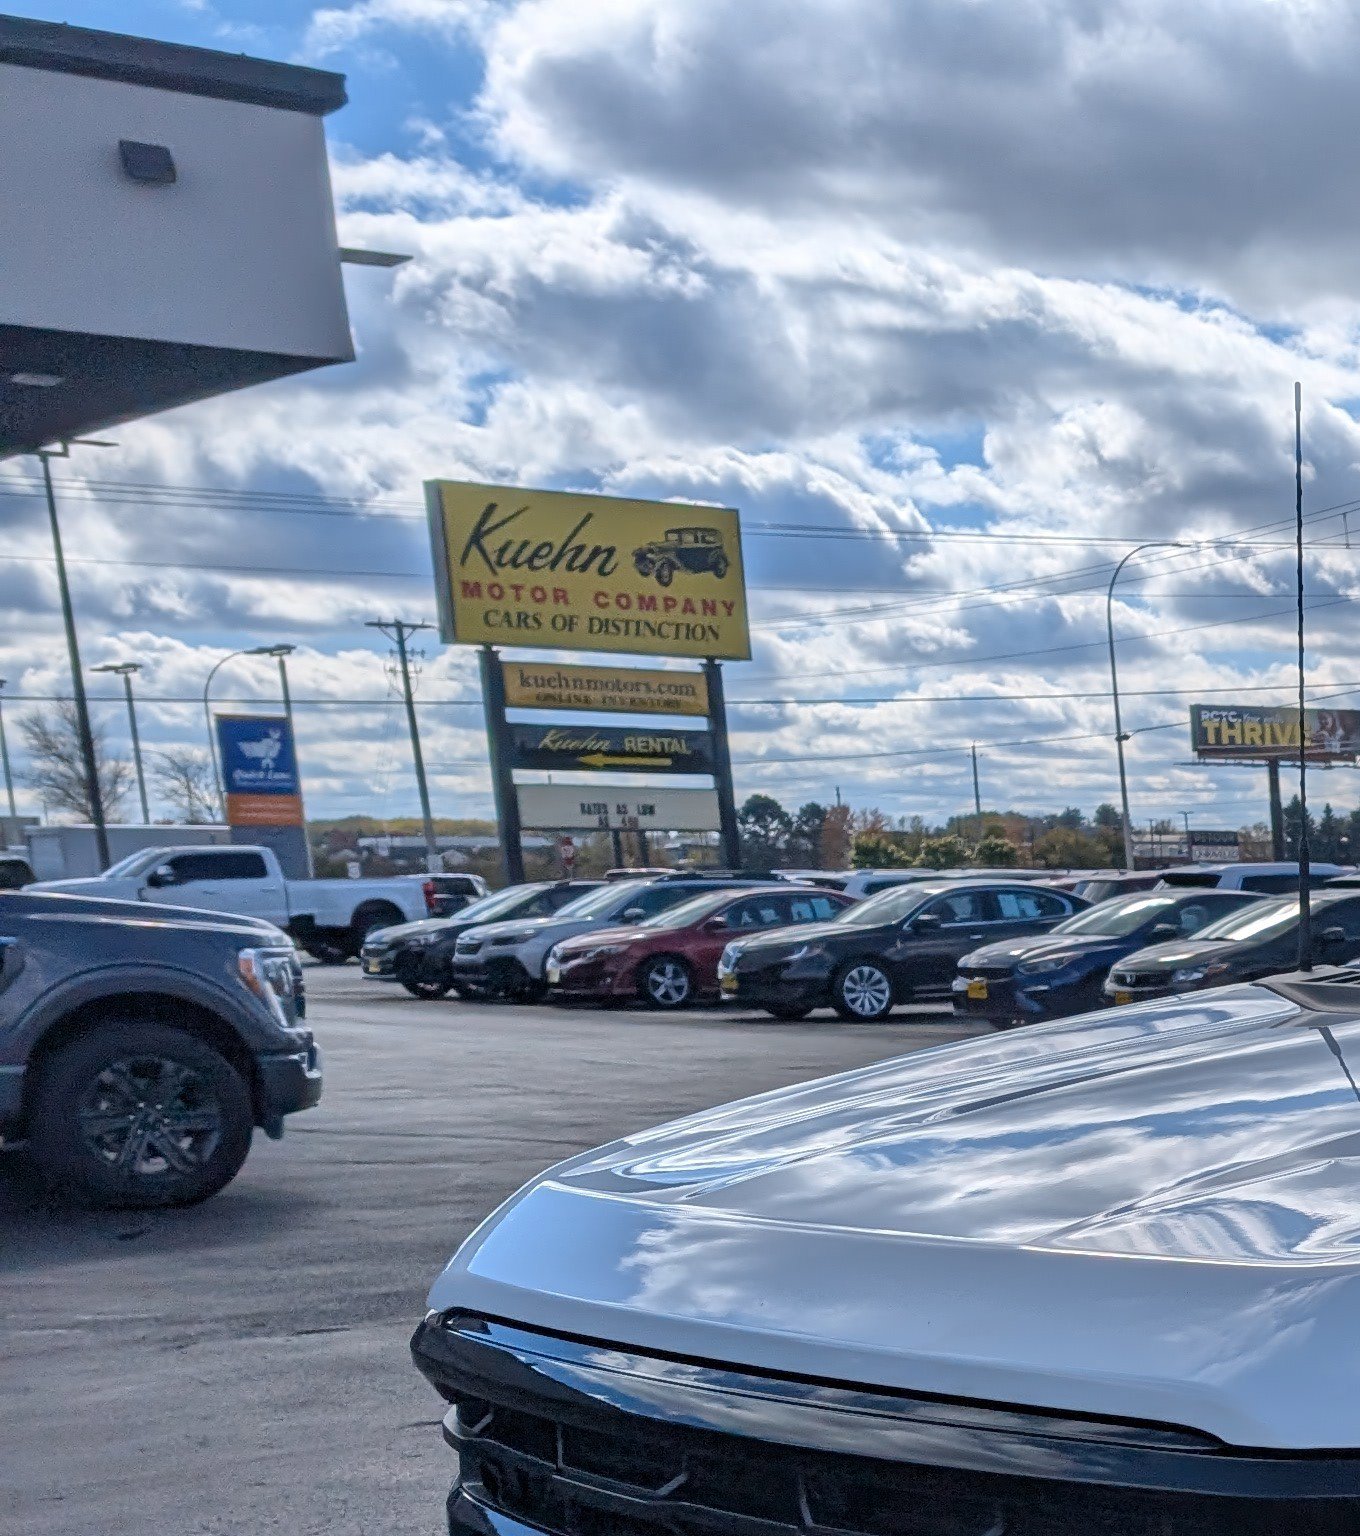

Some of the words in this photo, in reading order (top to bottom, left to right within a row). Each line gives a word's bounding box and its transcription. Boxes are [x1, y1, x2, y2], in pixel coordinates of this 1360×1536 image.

[460, 502, 619, 577] Kuehn
[460, 579, 571, 606] MOTOR
[592, 590, 736, 618] COMPANY
[482, 608, 542, 631] CARS
[550, 613, 580, 633] OF
[587, 616, 721, 642] DISTINCTION
[518, 669, 697, 697] kuehnmotors.com
[538, 728, 612, 751] Kuehn
[623, 735, 692, 755] RENTAL
[1200, 718, 1314, 747] THRIVE
